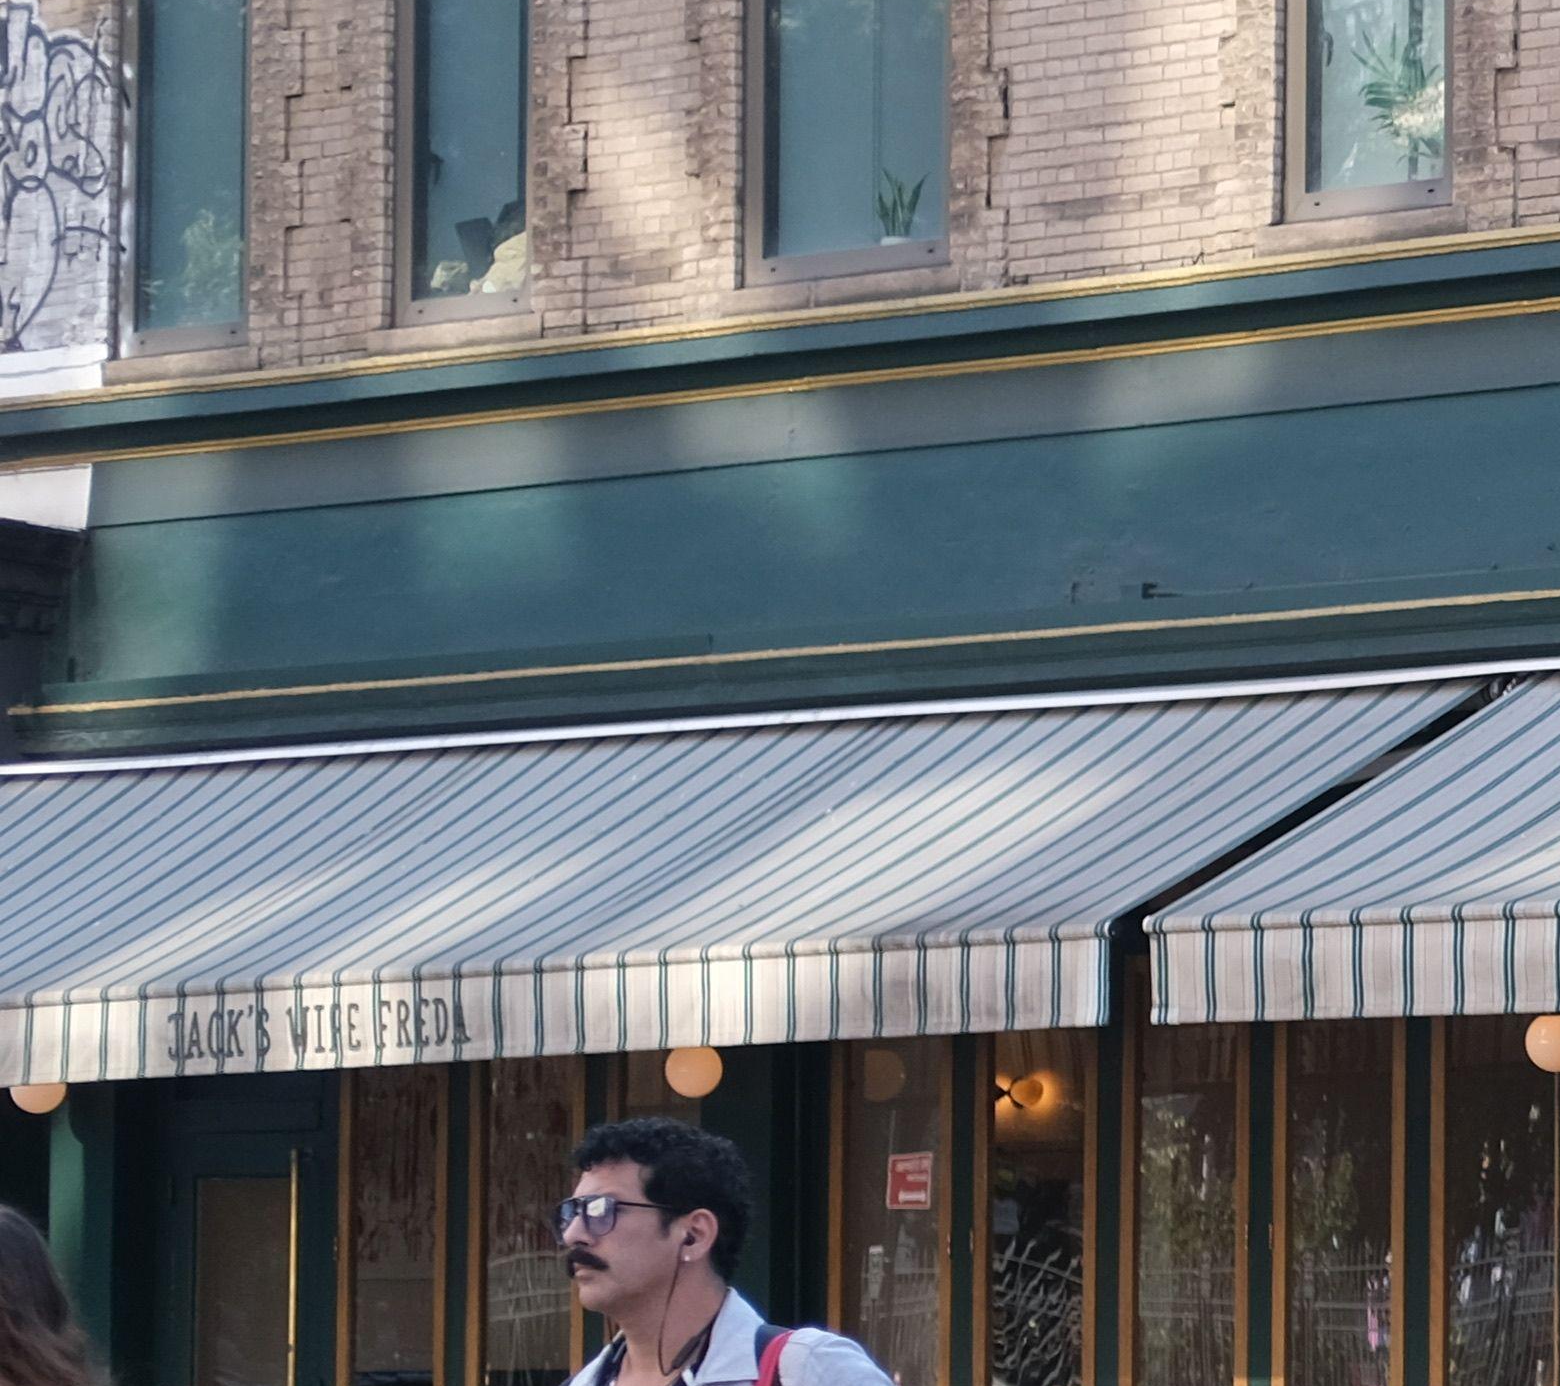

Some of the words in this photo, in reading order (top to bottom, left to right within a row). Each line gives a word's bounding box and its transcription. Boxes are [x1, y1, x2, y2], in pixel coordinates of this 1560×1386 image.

[167, 1004, 271, 1062] JACK'S
[285, 1002, 362, 1056] WIFE
[375, 997, 472, 1049] FREDA
